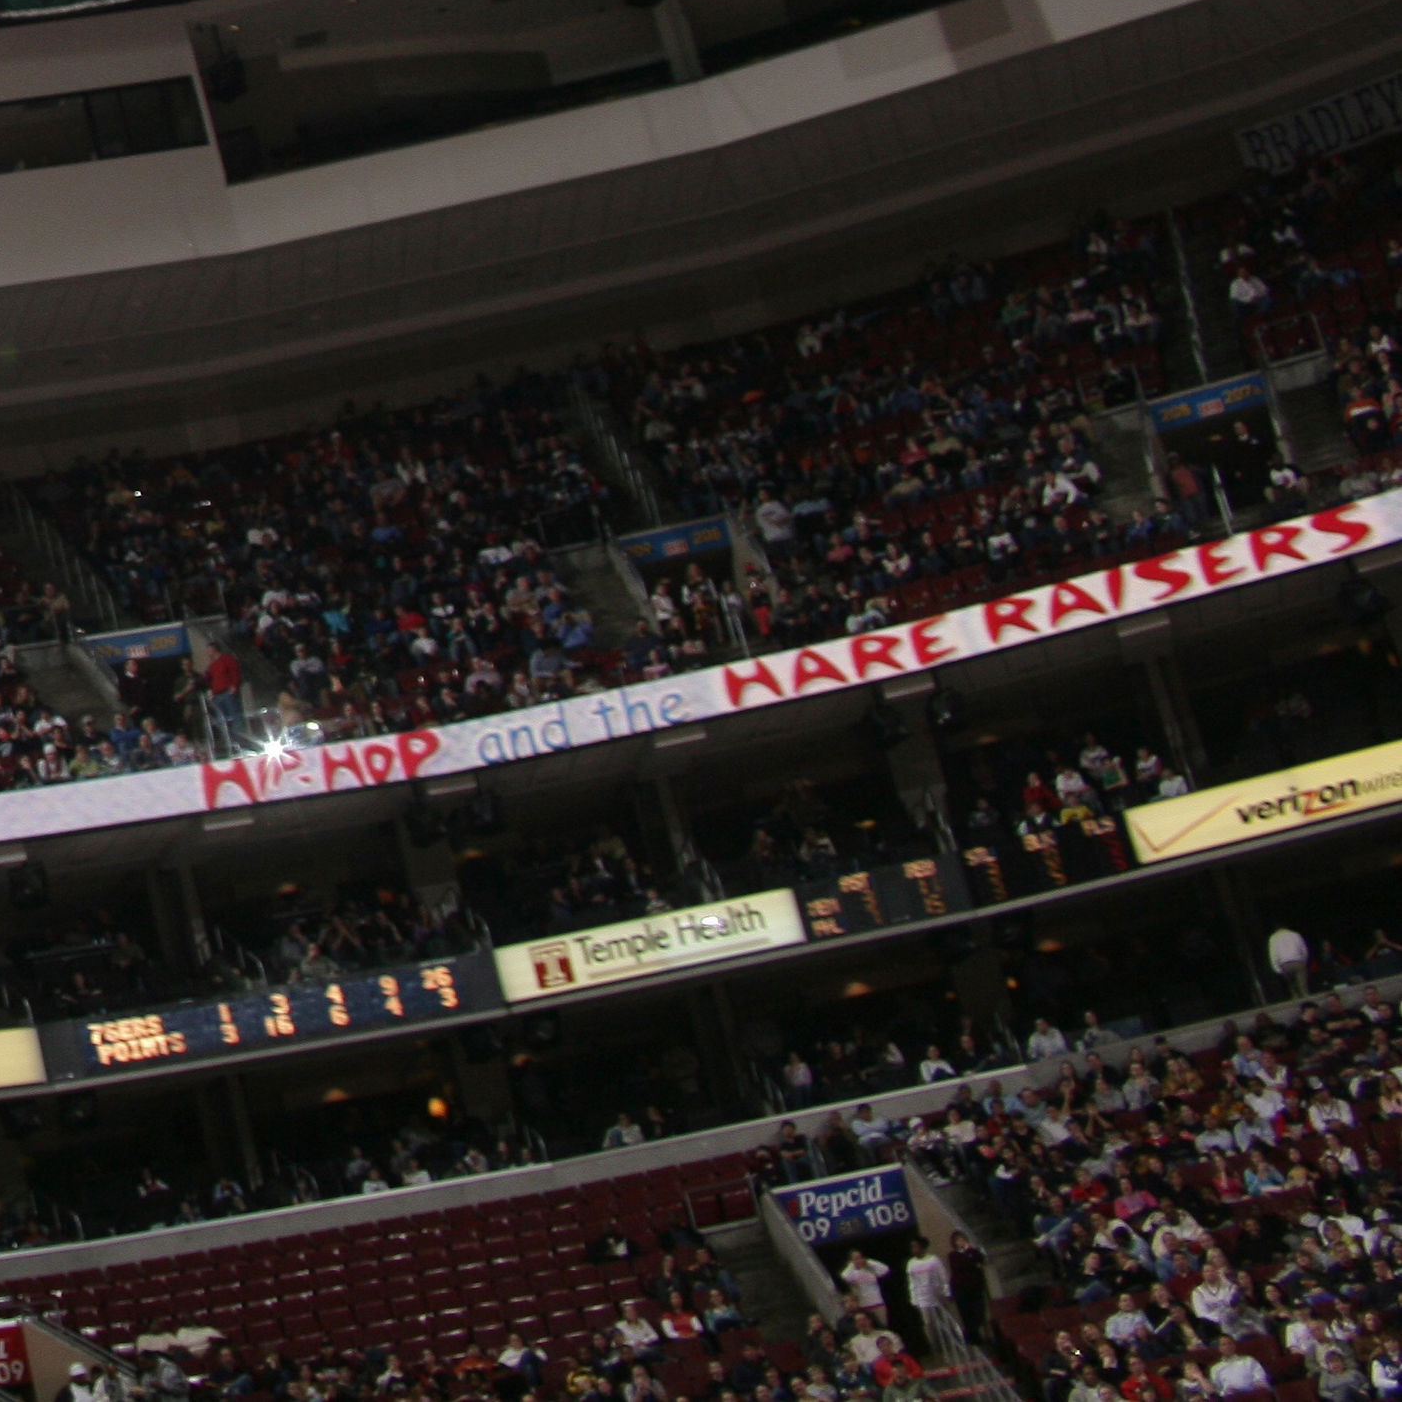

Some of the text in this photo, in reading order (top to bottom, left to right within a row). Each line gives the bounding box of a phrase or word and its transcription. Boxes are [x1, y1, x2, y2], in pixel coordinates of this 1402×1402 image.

[477, 710, 571, 766] and
[592, 686, 693, 741] the
[722, 613, 956, 708] HARE
[984, 501, 1371, 645] RAISERS
[1236, 779, 1359, 824] verizon
[575, 923, 671, 964] Temple
[673, 902, 767, 946] Health
[798, 1176, 883, 1219] Pepcid
[864, 1201, 910, 1229] 108
